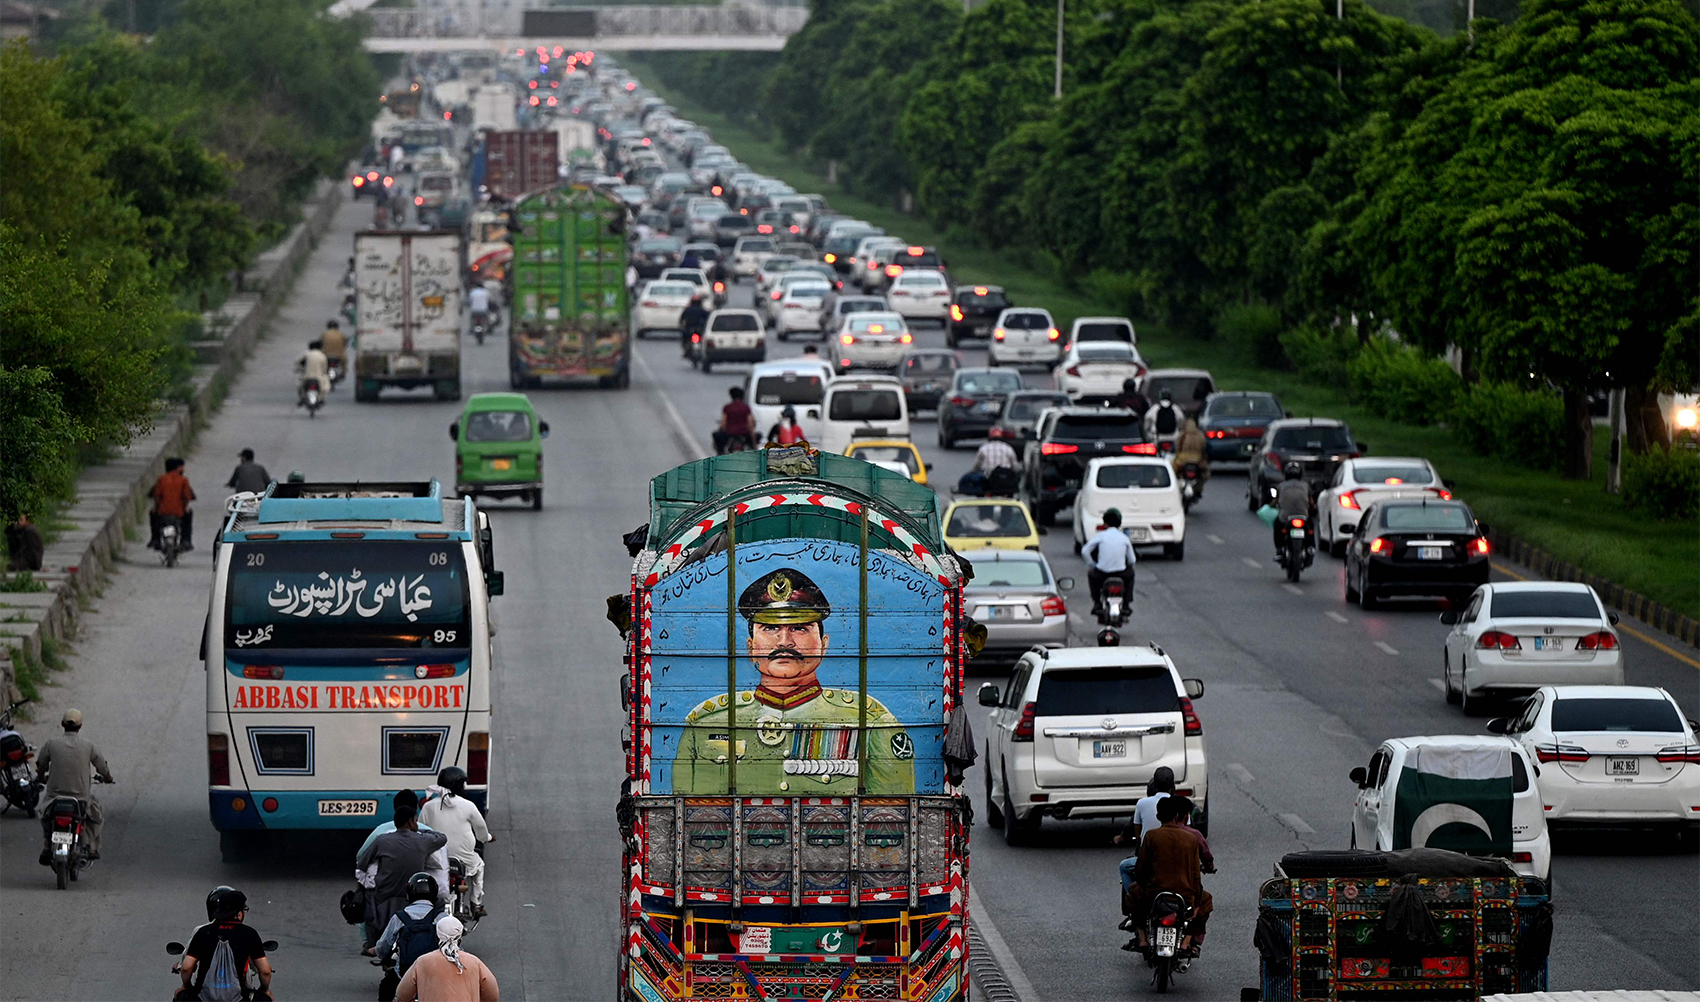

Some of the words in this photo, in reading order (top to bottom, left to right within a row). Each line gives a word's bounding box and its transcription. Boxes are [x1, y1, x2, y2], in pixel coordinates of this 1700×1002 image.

[247, 553, 265, 566] 20
[429, 552, 447, 566] 08
[812, 545, 842, 565] ہماری
[267, 567, 368, 618] ٹرانسپورٹ
[672, 571, 694, 597] شان
[235, 624, 273, 648] گروپ
[434, 629, 456, 643] 95
[233, 686, 318, 709] ABBASI
[326, 685, 464, 708] TRANSPORT
